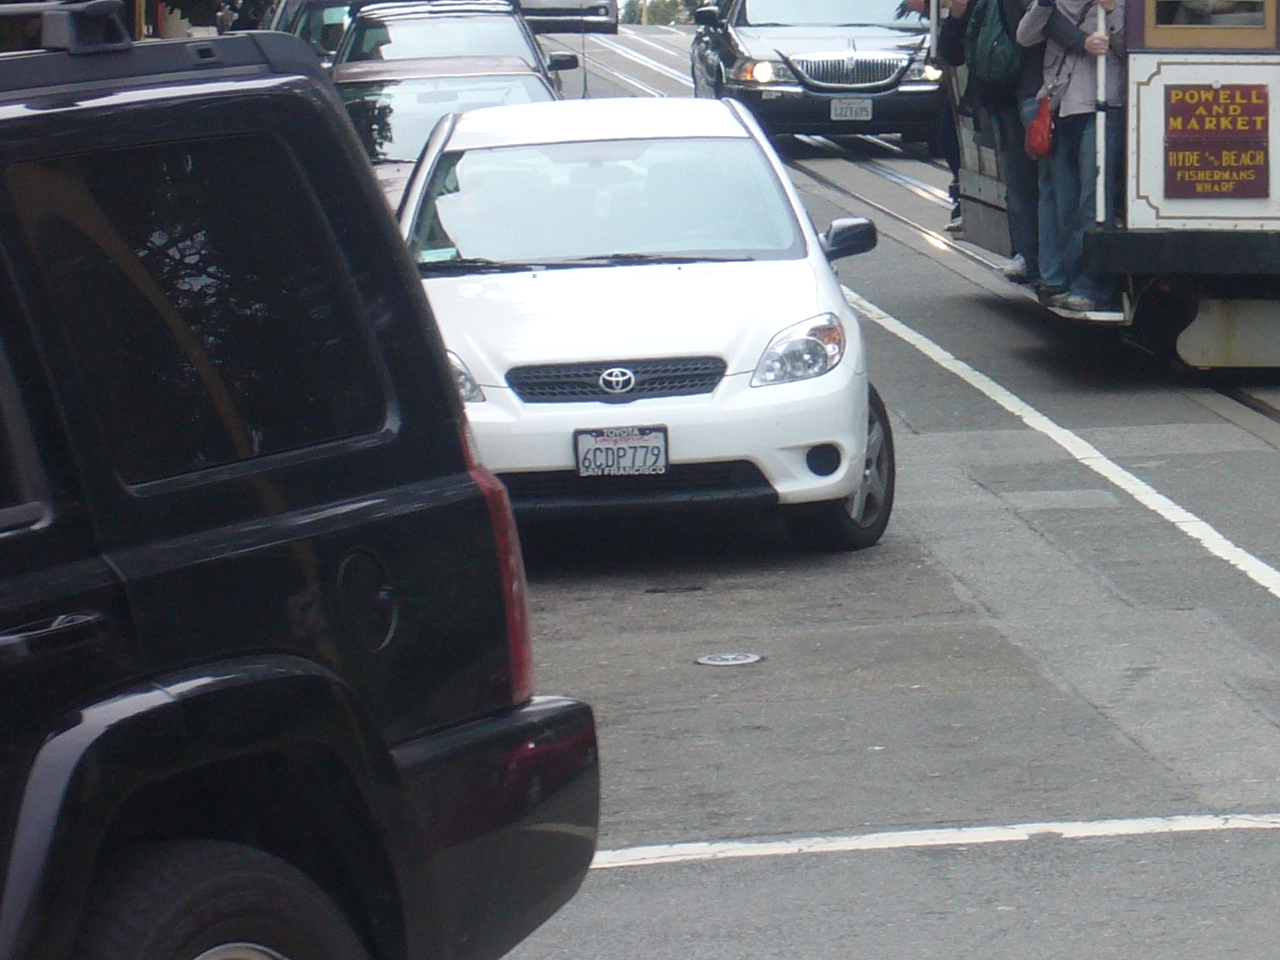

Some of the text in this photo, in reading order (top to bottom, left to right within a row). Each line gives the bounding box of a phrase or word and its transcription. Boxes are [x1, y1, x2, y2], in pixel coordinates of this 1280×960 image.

[1171, 90, 1264, 104] POWELL
[1194, 105, 1242, 116] AND
[1169, 116, 1266, 131] MARKET
[1169, 151, 1201, 167] HYDE
[1222, 150, 1266, 167] BEACH
[1177, 170, 1256, 181] FISHERMANS
[1195, 182, 1236, 193] WHARF
[603, 427, 640, 437] TOYOTA
[582, 445, 661, 469] 6CDP779
[580, 464, 666, 477] SAN FRANCISCO
